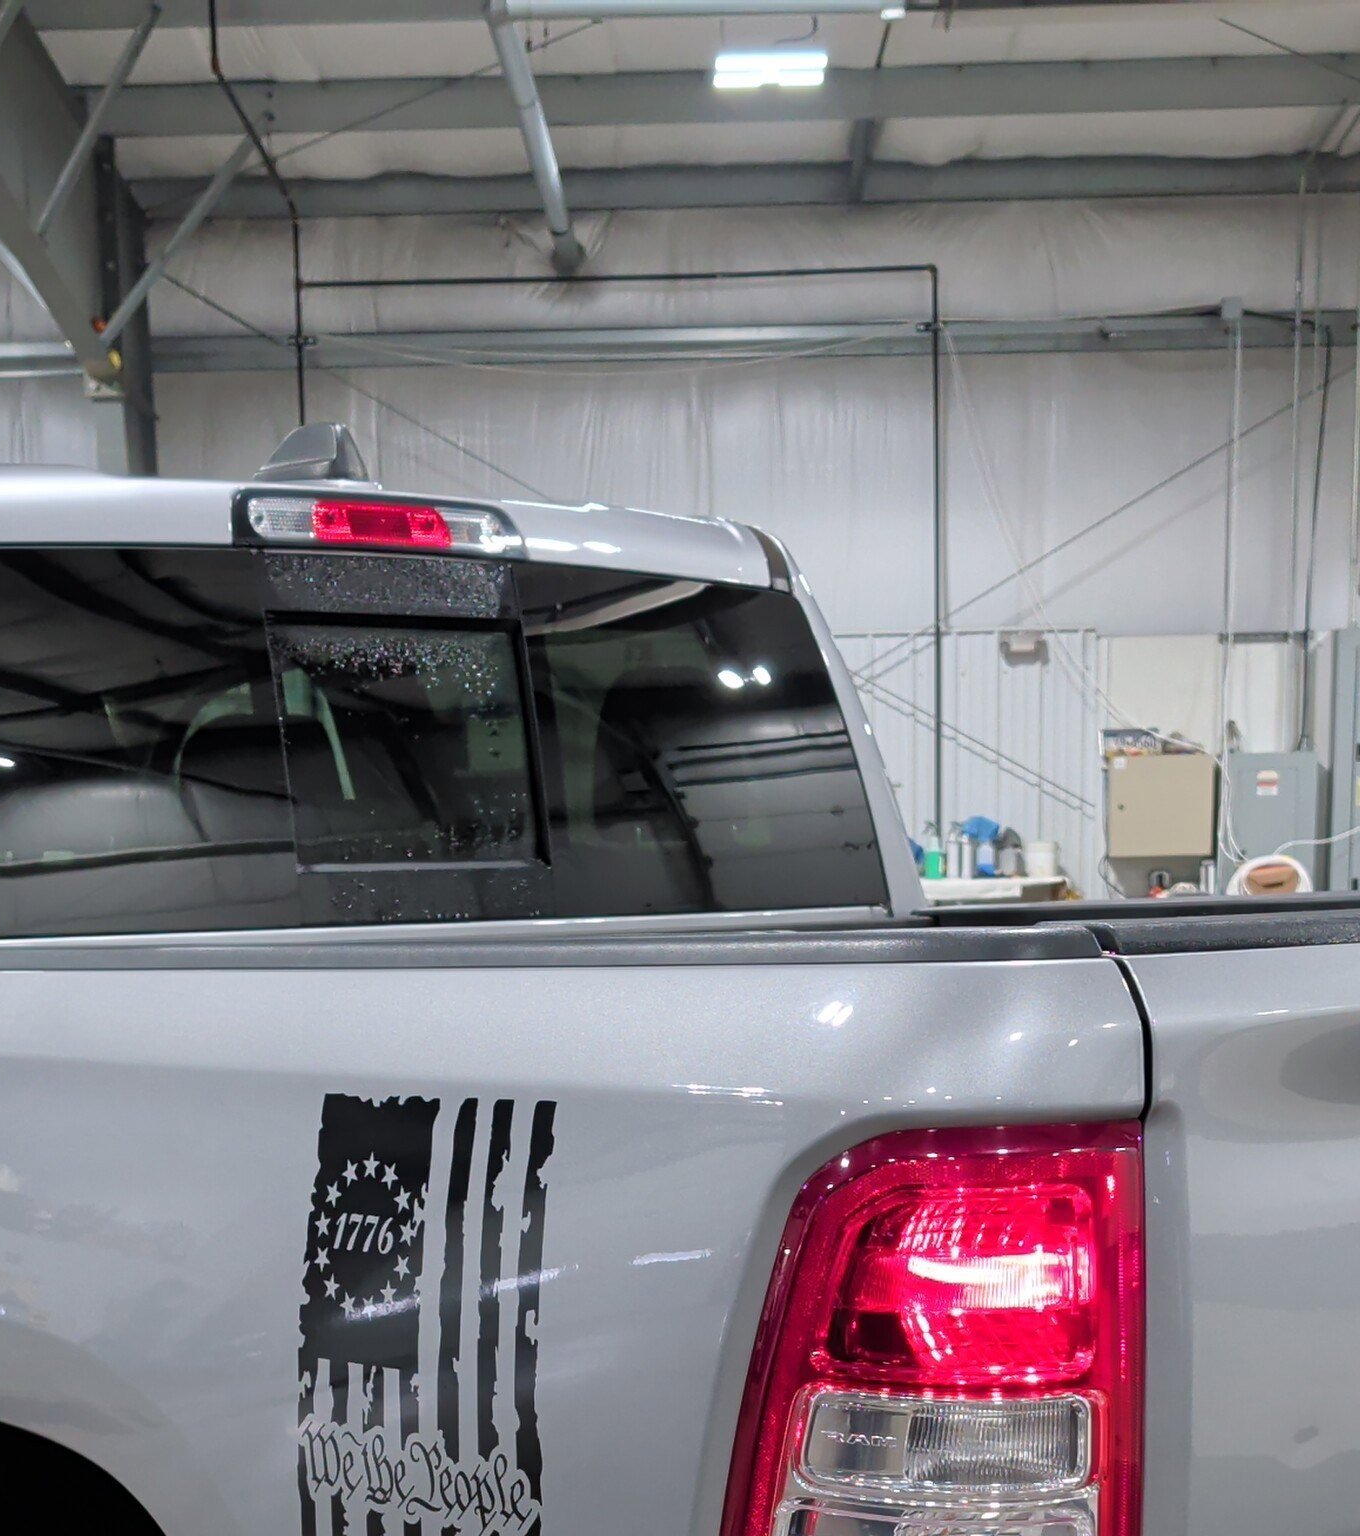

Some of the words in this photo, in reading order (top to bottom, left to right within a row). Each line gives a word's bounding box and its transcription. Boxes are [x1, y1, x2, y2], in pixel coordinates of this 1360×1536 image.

[334, 1214, 394, 1255] 1776
[301, 1421, 363, 1500] We
[362, 1432, 416, 1509] the
